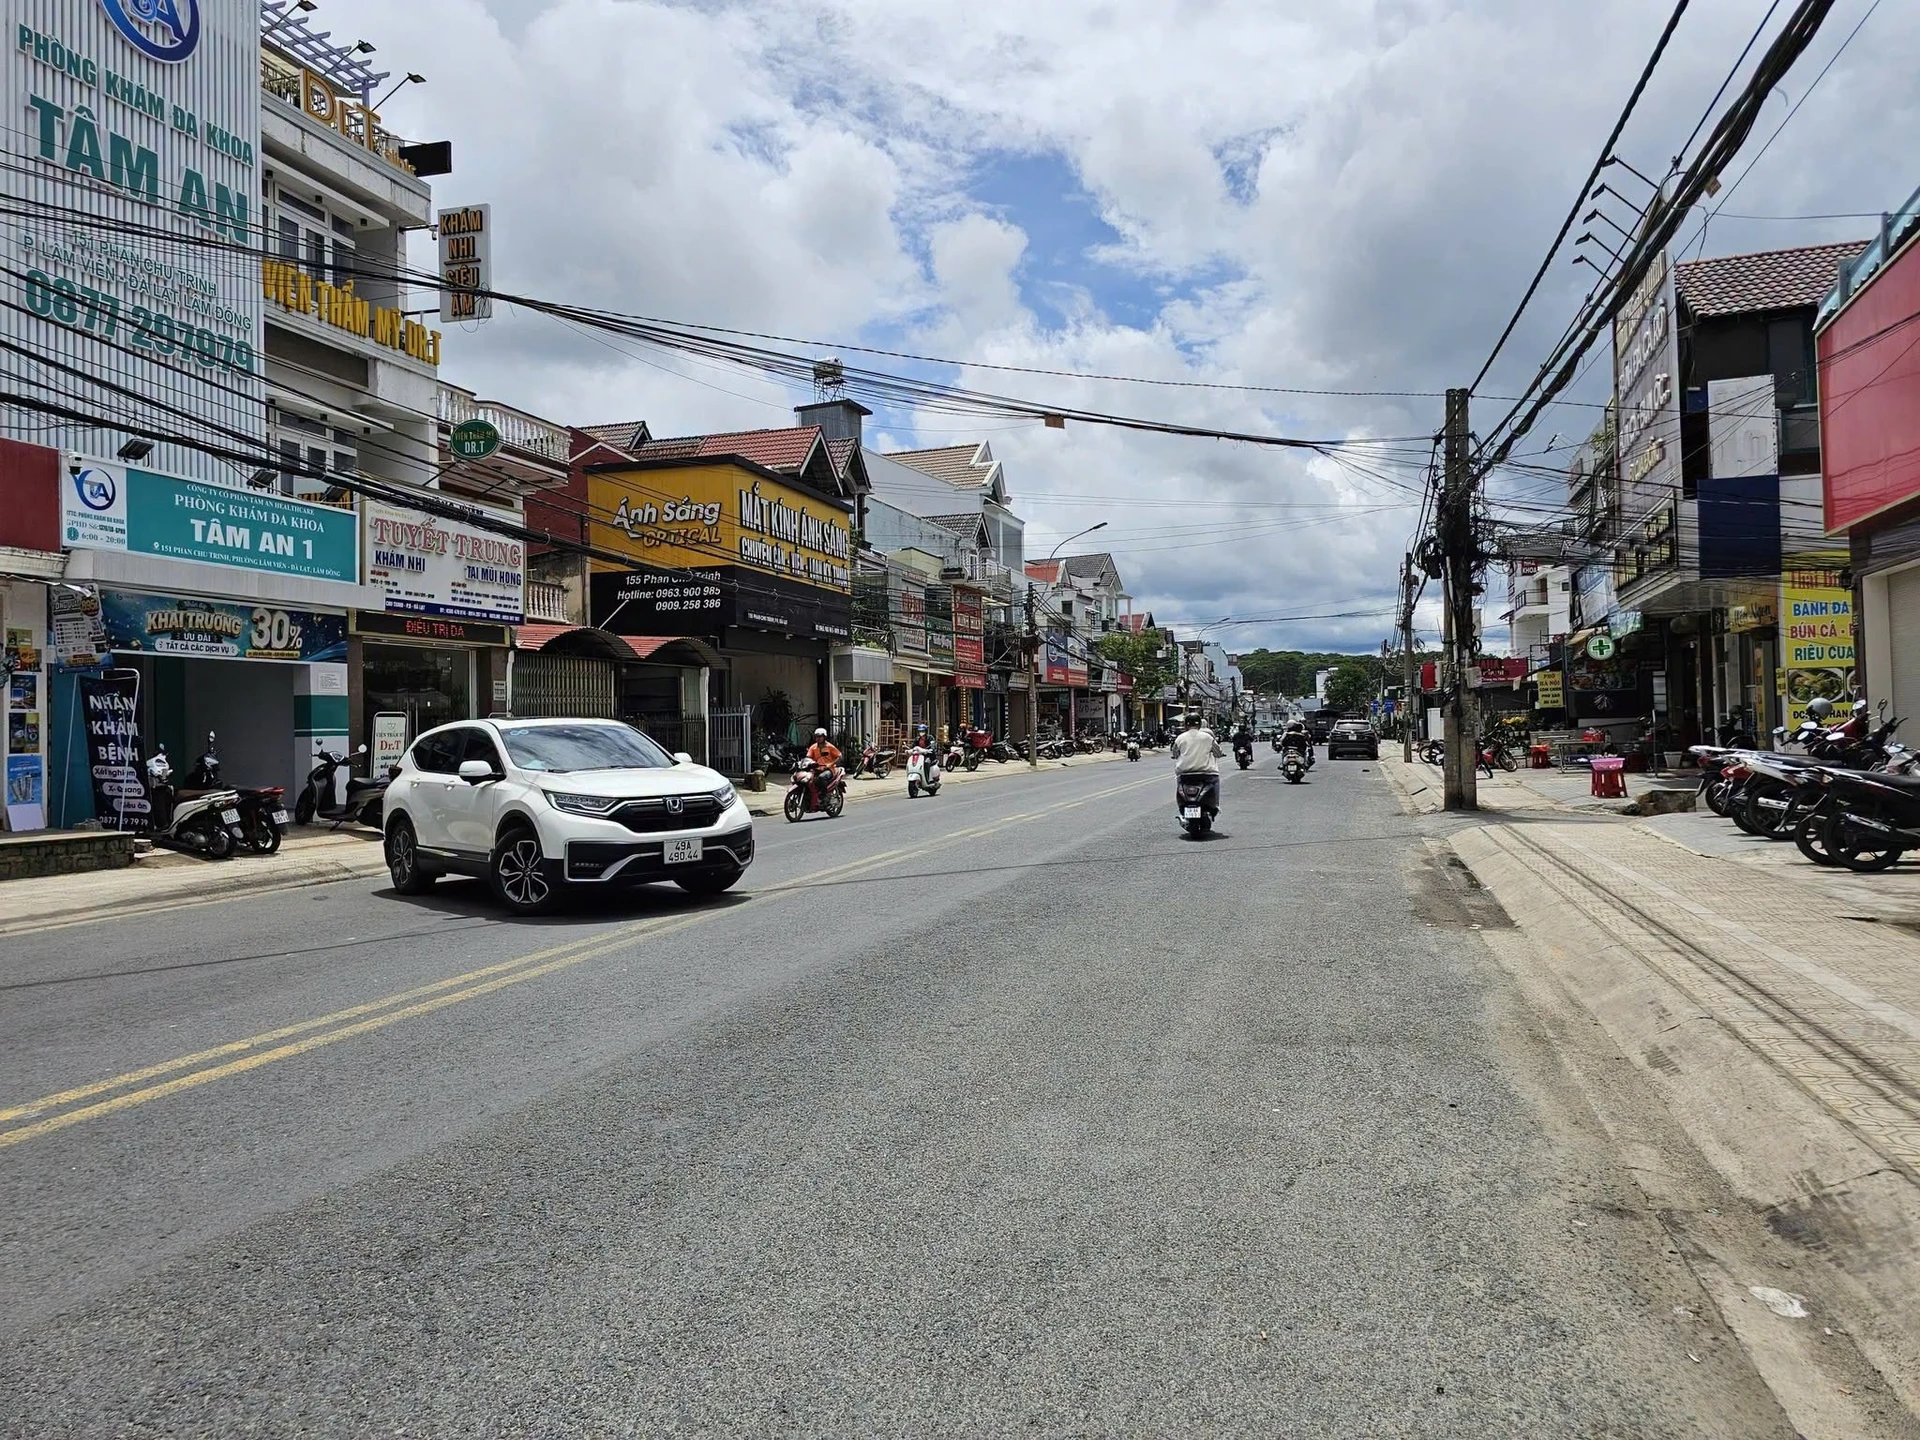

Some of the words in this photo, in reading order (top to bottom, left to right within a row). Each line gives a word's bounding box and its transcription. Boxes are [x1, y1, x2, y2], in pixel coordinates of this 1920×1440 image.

[19, 23, 97, 88] PHÒNG
[105, 67, 166, 123] KHÁM
[172, 104, 199, 140] ĐA
[206, 121, 255, 167] KHOA
[29, 93, 159, 205] TÂM
[176, 167, 249, 245] AN
[440, 207, 483, 236] KHÁM
[448, 236, 476, 259] NHI
[101, 241, 140, 267] PHAN
[178, 269, 218, 297] TRINH
[445, 264, 480, 289] SIÊU
[42, 241, 76, 267] LÂM
[80, 257, 116, 283] VIÊN
[128, 272, 150, 294] ĐÀ
[183, 290, 212, 317] LÂM
[215, 303, 253, 331] ĐỒNG
[263, 256, 312, 314] VIỆN
[25, 268, 121, 339] 0877
[130, 305, 255, 380] 297979
[465, 441, 485, 454] DR.T
[174, 494, 225, 515] PHÒNG
[229, 504, 268, 523] KHÁM
[271, 512, 288, 527] ĐA
[291, 518, 325, 533] KHOA
[265, 500, 275, 508] AN
[613, 497, 657, 532] Ánh
[662, 495, 722, 526] Sáng
[82, 533, 98, 541] 6:00
[106, 536, 126, 545] 20:00
[190, 518, 250, 550] TÂM
[259, 531, 294, 557] AN
[302, 539, 313, 560] 1
[643, 527, 721, 547] OPTICAL
[771, 497, 799, 543] KÍNH
[800, 506, 824, 550] ÁNH
[824, 518, 850, 561] SÁNG
[374, 516, 450, 555] TUYẾT
[455, 533, 522, 567] TRUNG
[375, 549, 405, 569] KHÁM
[407, 557, 426, 572] NHI
[1523, 566, 1538, 575] KHOA
[467, 565, 479, 579] TAI
[481, 566, 497, 583] MŨI
[500, 571, 522, 589] HỌNG
[626, 575, 641, 585] 155
[644, 574, 669, 585] Phan
[617, 589, 654, 600] Hotline:
[656, 588, 680, 599] 0963.
[683, 586, 700, 597] 900
[703, 585, 721, 596] 985
[656, 601, 681, 612] 0909.
[683, 599, 700, 610] 258
[703, 598, 721, 609] 386
[1793, 599, 1828, 617] BÁNH
[1831, 601, 1850, 615] ĐA
[146, 611, 184, 635] KHAI
[186, 611, 243, 638] TRƯƠNG
[251, 607, 303, 650] 30%
[1790, 621, 1816, 639] BÚN
[1820, 620, 1837, 638] CÁ
[166, 640, 179, 651] TẤT
[191, 643, 204, 652] CÁC
[205, 644, 221, 654] DỊCH
[184, 632, 195, 642] ƯU
[1795, 644, 1825, 661] RIÊU
[1828, 645, 1856, 660] CUA
[89, 691, 135, 715] NHẬN
[92, 717, 139, 737] KHÁM
[98, 742, 139, 765] BỆNH
[380, 740, 401, 751] Dr.T
[668, 850, 699, 862] 490.44
[675, 840, 692, 851] 49A
